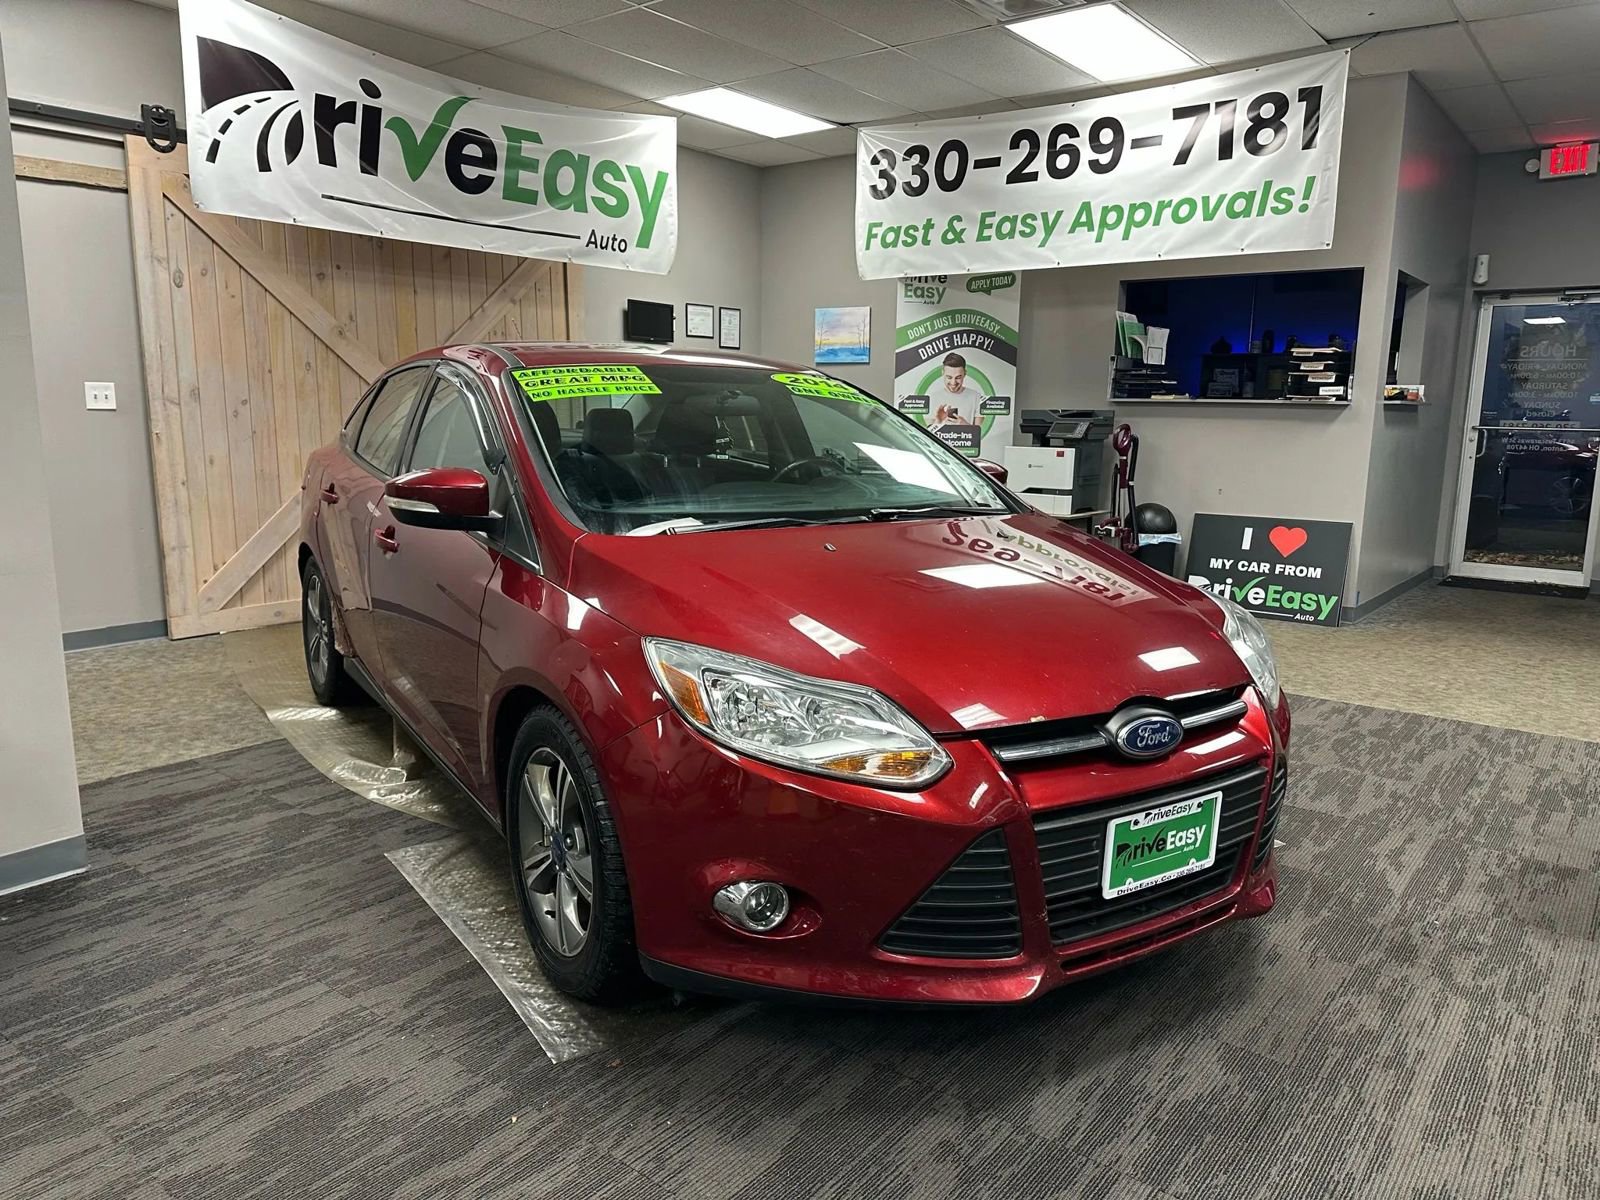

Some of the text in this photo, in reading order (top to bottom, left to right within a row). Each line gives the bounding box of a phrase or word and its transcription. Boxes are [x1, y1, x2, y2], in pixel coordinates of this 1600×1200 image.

[197, 36, 668, 248] DriveEasy
[869, 85, 1324, 200] 330-269-7181
[1551, 144, 1591, 175] EXIT
[865, 175, 1316, 251] Fast & Easy Approvals!
[585, 229, 628, 253] Auto
[904, 283, 947, 304] Easy
[971, 275, 1013, 290] APPLY TODAY
[907, 321, 932, 340] DON'T
[934, 315, 952, 330] JUST
[918, 333, 995, 360] DRIVE HAPPY!
[518, 367, 637, 379] AFFORDABLE
[524, 375, 646, 388] GREAT MPG
[532, 384, 657, 399] NO HASSLE PRICE
[1241, 527, 1253, 550] I
[1209, 557, 1322, 579] MY CAR FROM
[1294, 613, 1314, 622] Auto
[1136, 722, 1171, 748] Ford
[1143, 802, 1194, 825] DriveEasy
[1115, 824, 1206, 869] DriveEasy
[1183, 845, 1195, 853] Auto
